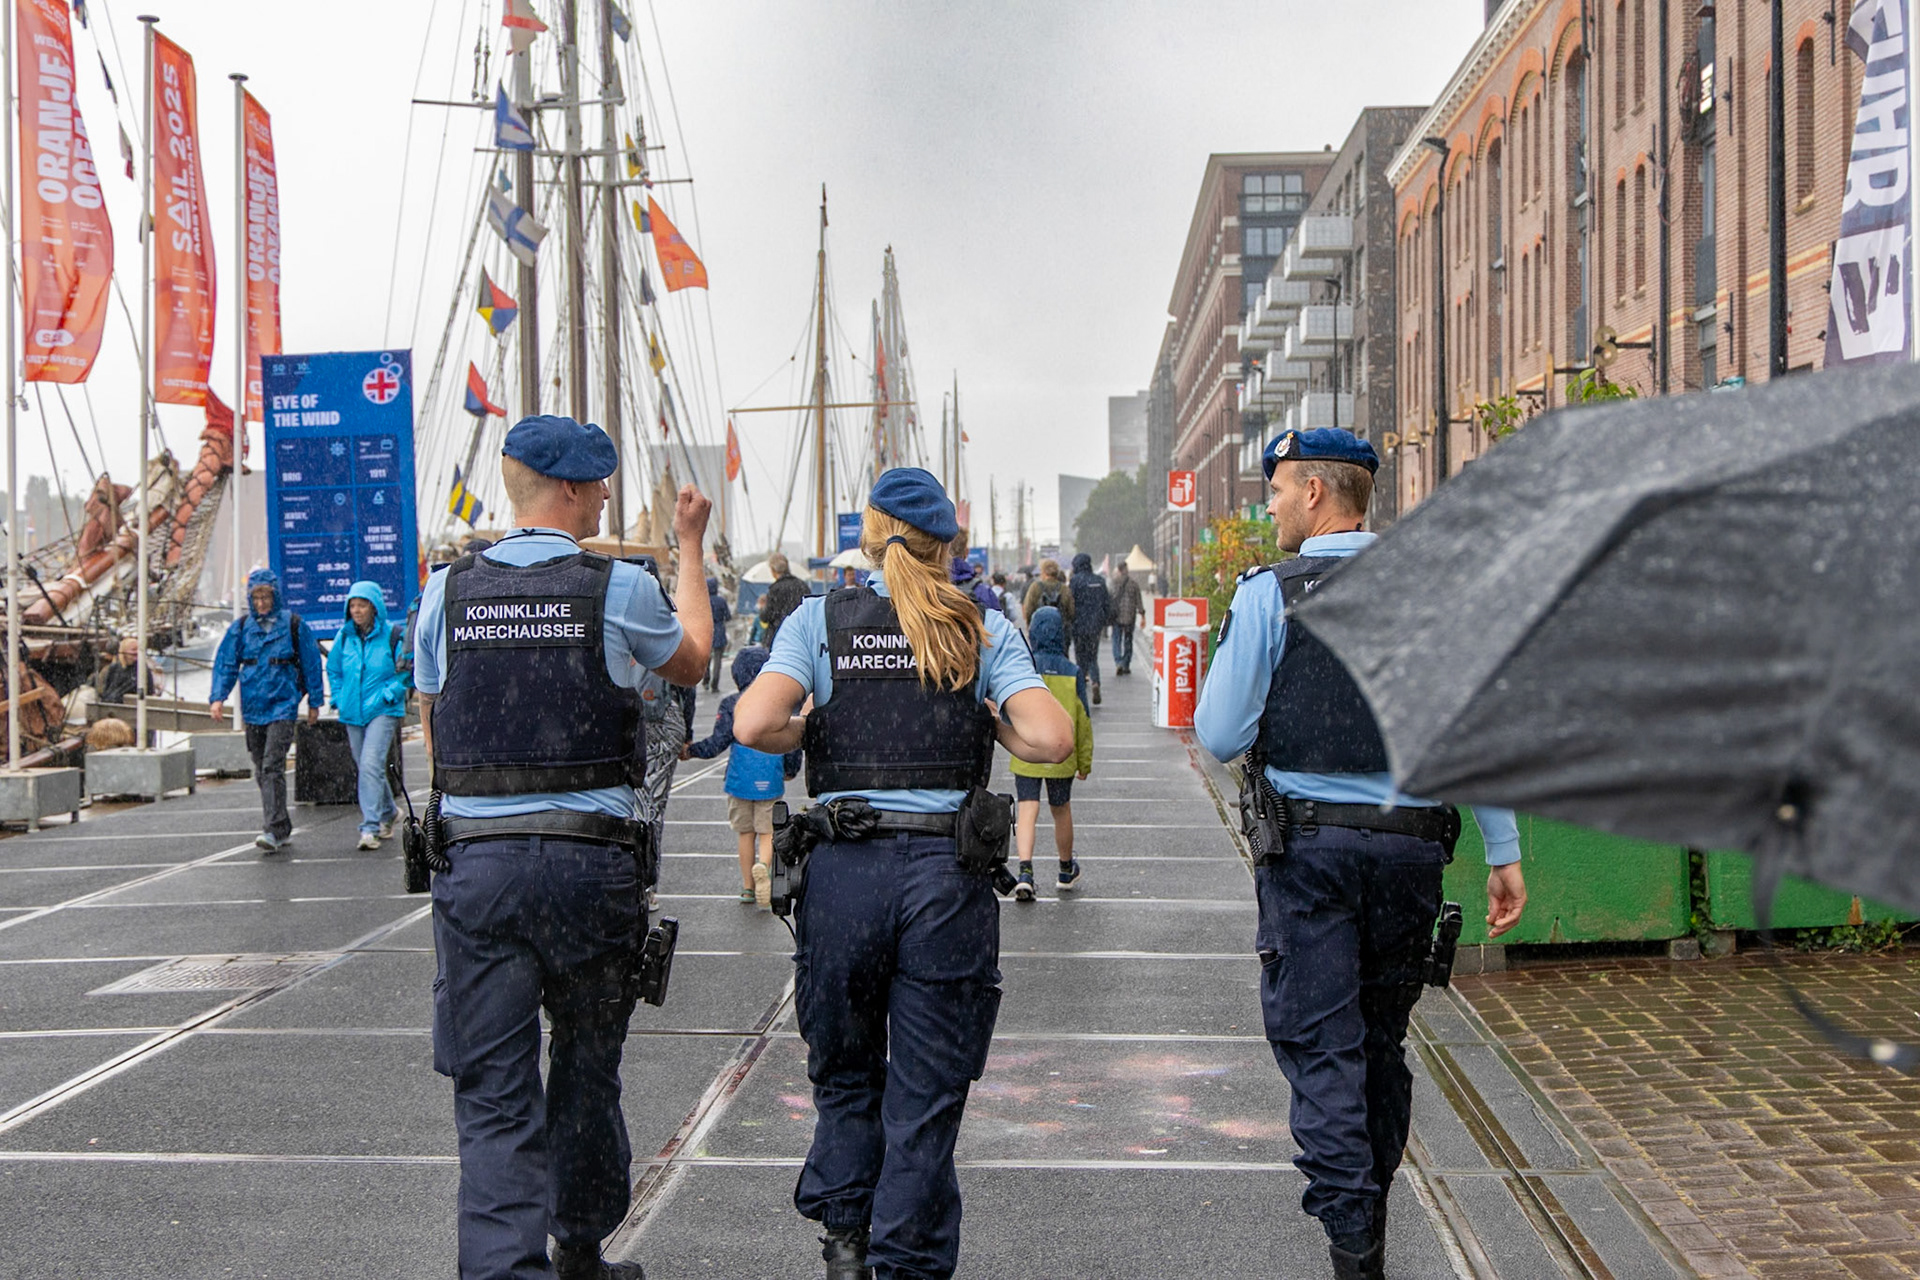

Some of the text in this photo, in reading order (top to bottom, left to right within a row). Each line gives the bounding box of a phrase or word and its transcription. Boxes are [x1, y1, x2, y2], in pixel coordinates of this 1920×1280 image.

[163, 62, 193, 254] SAIL 2025
[272, 395, 299, 410] EVE
[301, 394, 319, 409] OF
[272, 410, 341, 428] THE WIND
[366, 555, 397, 564] 2025
[466, 603, 571, 620] KONINKLIJKE
[454, 623, 586, 641] MARECHAUSSEE
[837, 654, 920, 670] MARECHA
[1175, 643, 1193, 693] Afval
